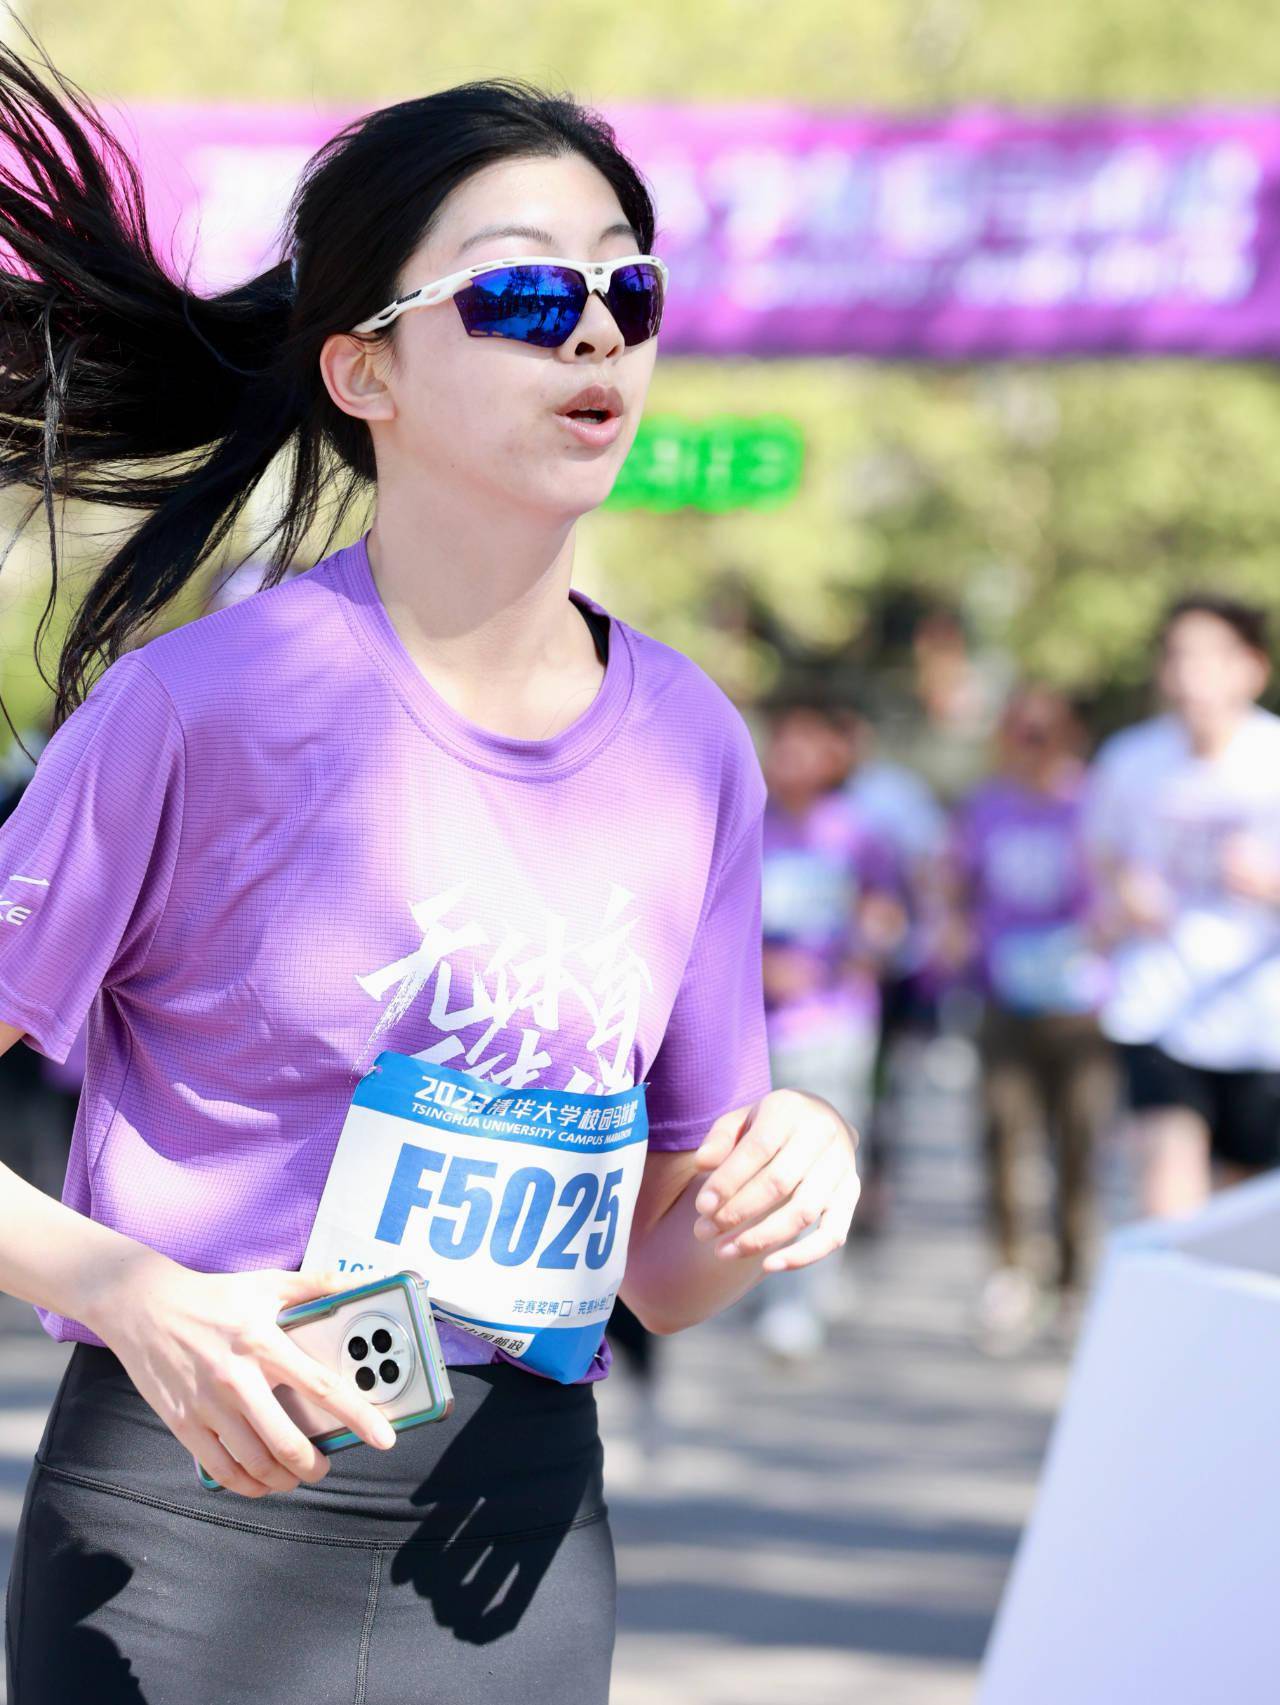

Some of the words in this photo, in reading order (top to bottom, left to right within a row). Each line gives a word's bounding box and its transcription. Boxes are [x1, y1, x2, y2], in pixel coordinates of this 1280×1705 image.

[412, 1101, 480, 1129] TSINGHUA
[481, 1118, 556, 1140] UNIVERSITY
[558, 1131, 606, 1146] CAMPUS
[374, 1142, 624, 1272] F5025
